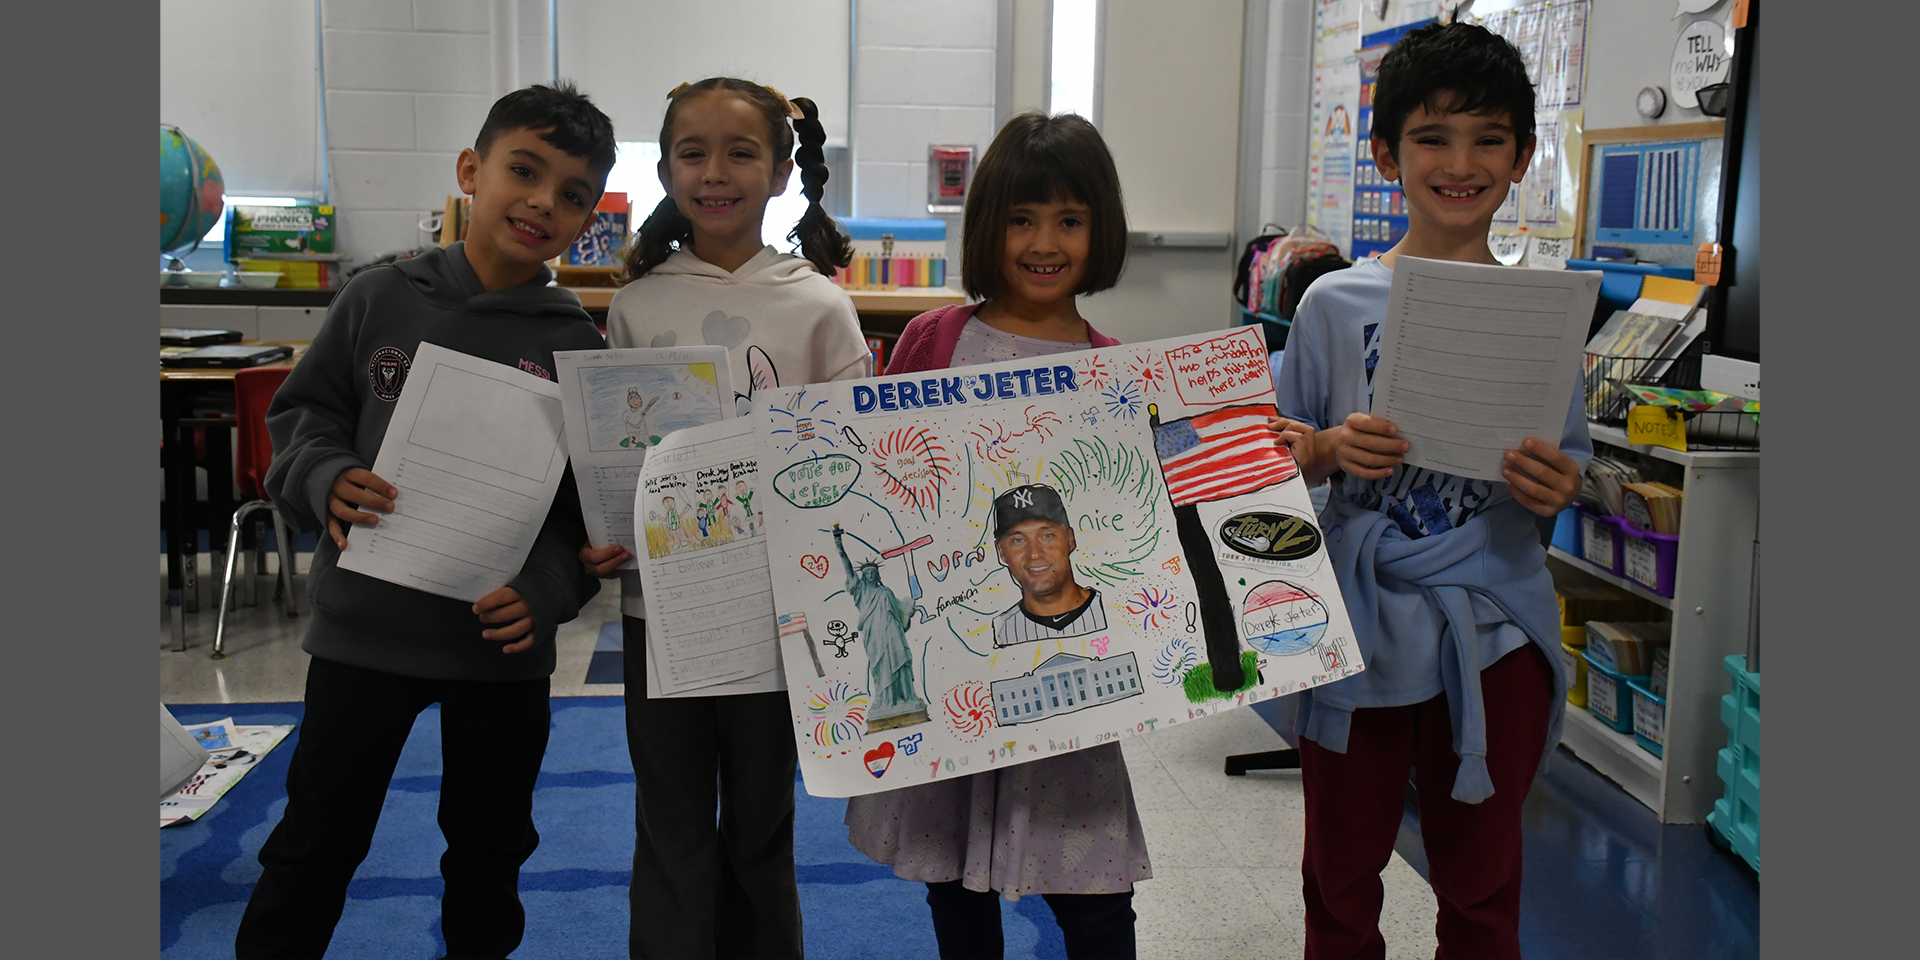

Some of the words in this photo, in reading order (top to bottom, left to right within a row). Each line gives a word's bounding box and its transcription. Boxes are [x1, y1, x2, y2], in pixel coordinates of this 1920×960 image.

[1687, 35, 1713, 54] TELL
[1695, 53, 1720, 73] WHY
[257, 215, 310, 223] PHONICS
[1537, 242, 1561, 257] SENSE
[1179, 363, 1200, 373] two
[1188, 368, 1221, 388] helps
[853, 376, 969, 413] DEREK
[973, 365, 1079, 401] JETER
[897, 455, 916, 468] good
[1078, 508, 1124, 531] nice
[1273, 516, 1315, 552] 2
[1222, 553, 1240, 561] TURN
[1327, 652, 1341, 668] 2
[906, 744, 914, 753] 2
